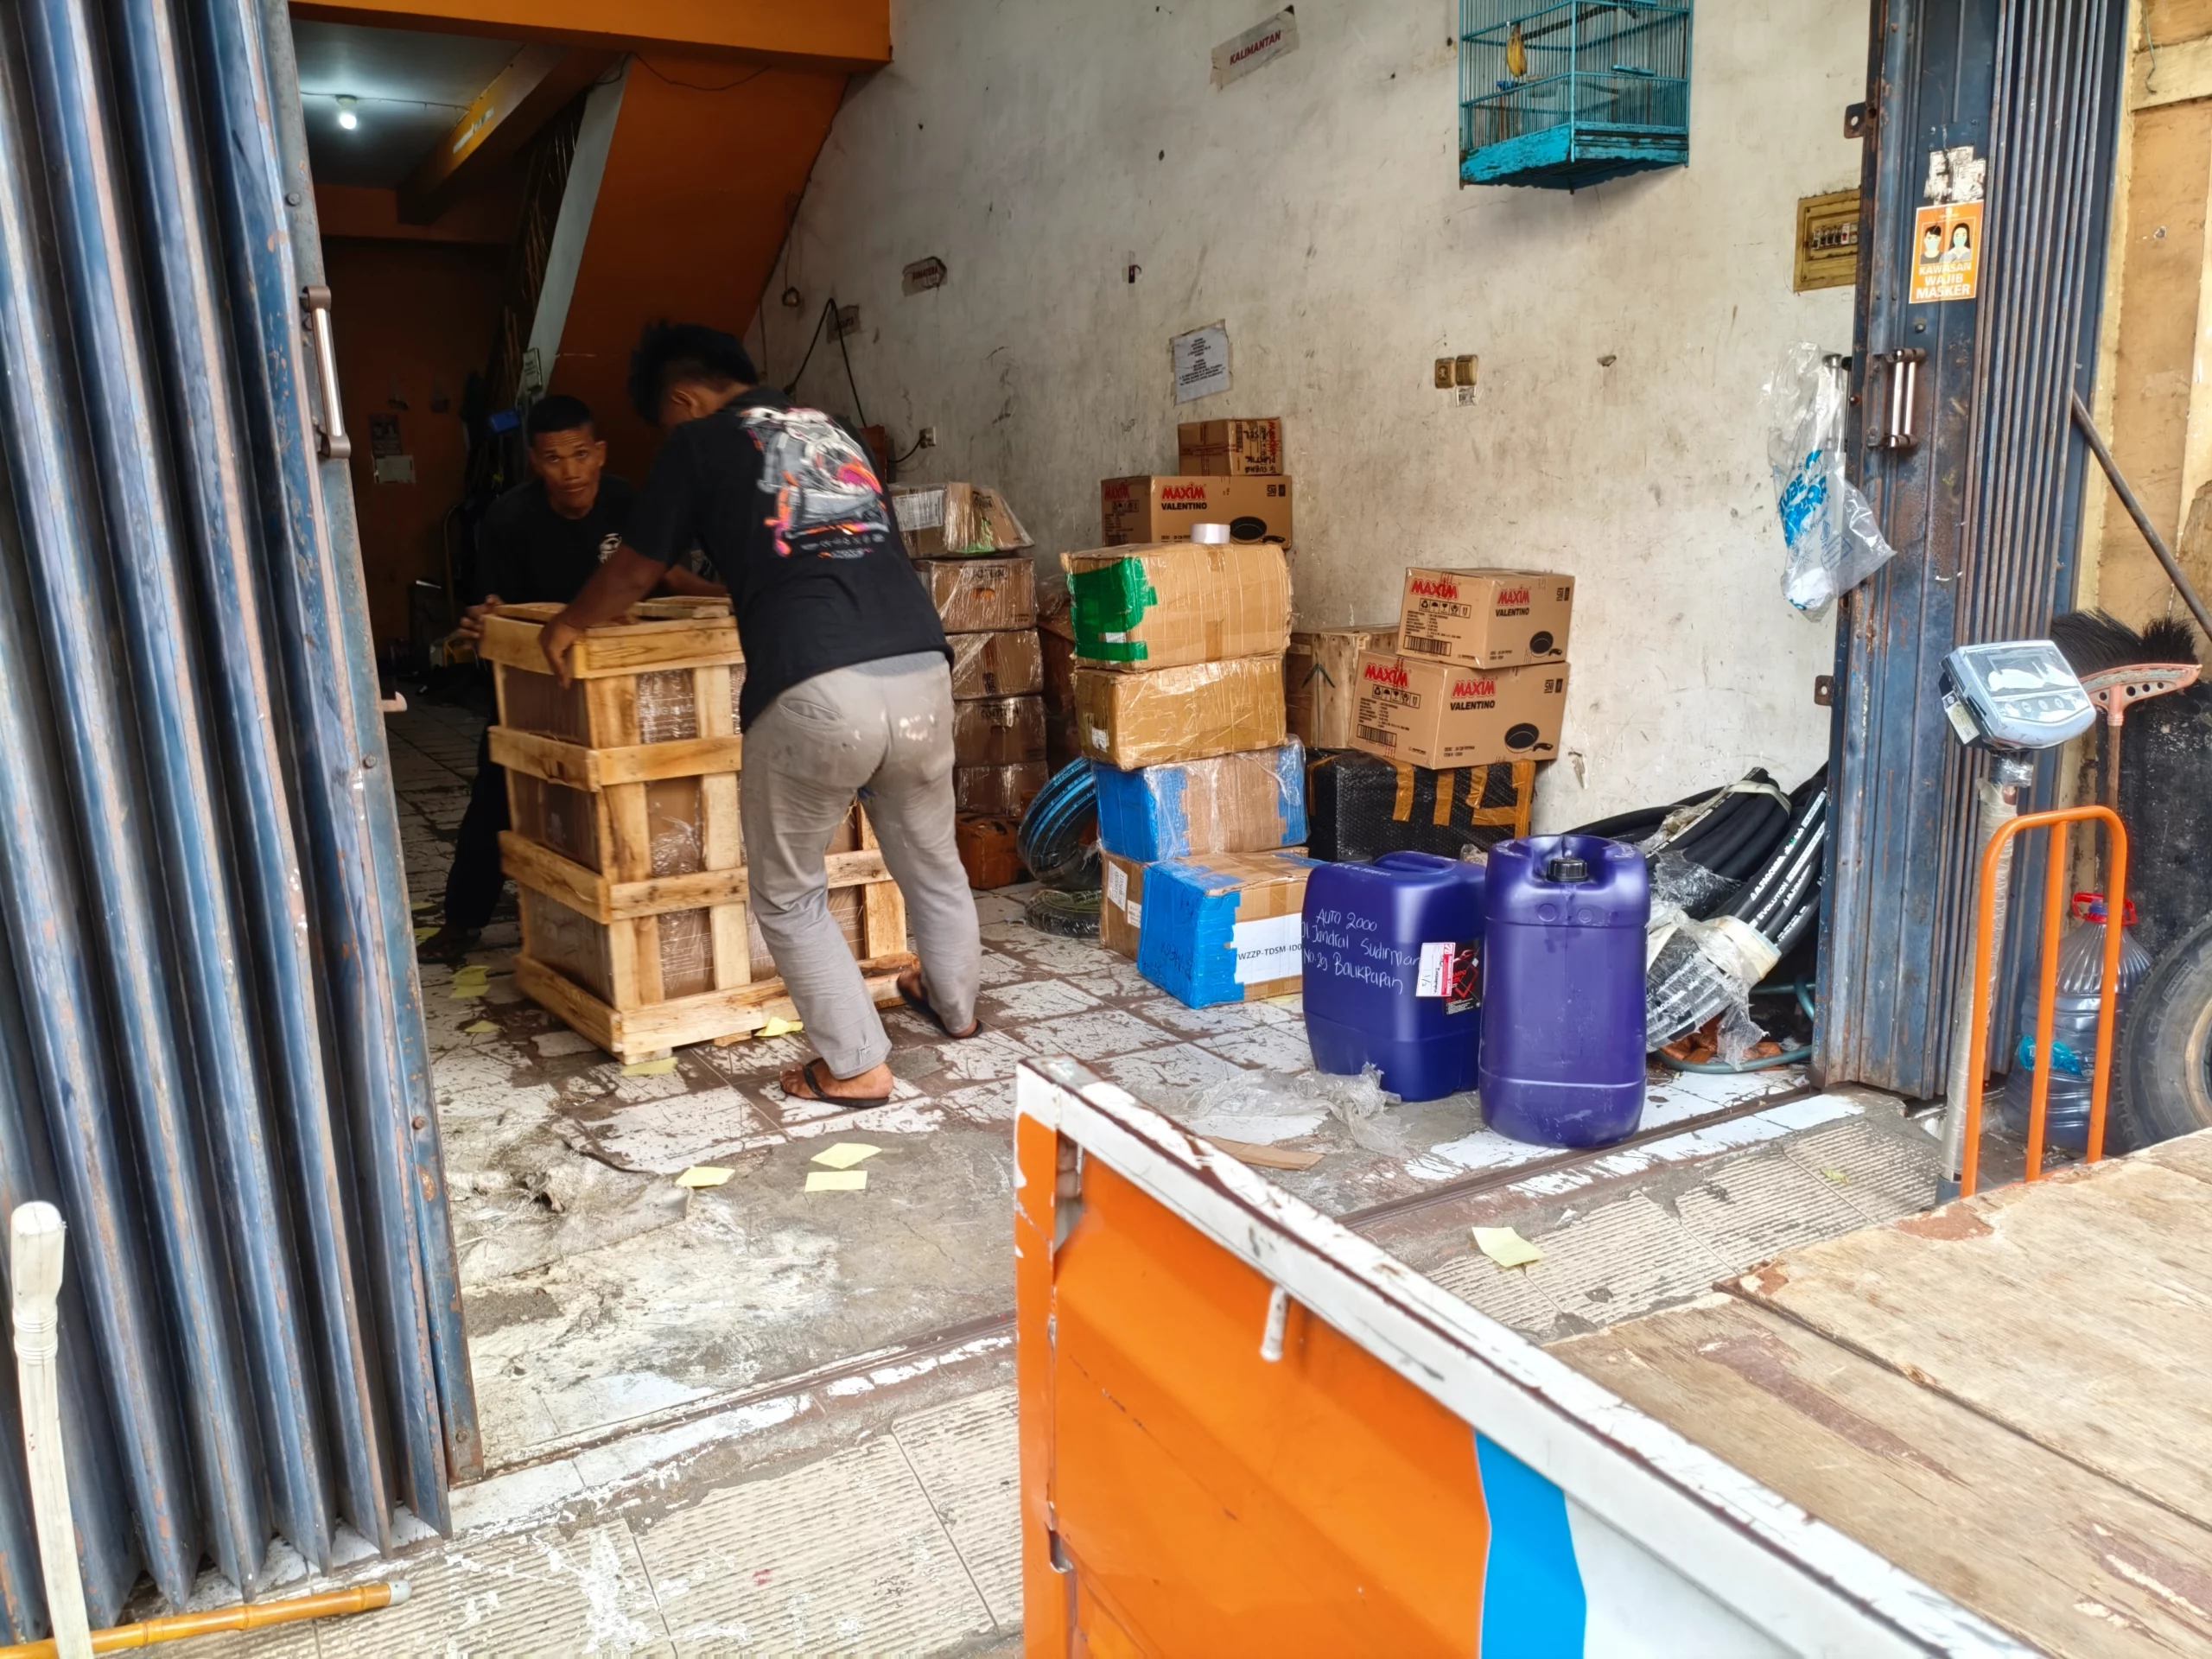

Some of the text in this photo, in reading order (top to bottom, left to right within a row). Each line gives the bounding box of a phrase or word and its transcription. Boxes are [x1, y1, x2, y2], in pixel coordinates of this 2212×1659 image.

[1230, 30, 1281, 66] KALIMANTAN
[1918, 262, 1973, 276] KAWASAN
[1924, 273, 1963, 286] WAJIB
[1915, 283, 1971, 300] MASKER
[1161, 482, 1206, 500] MAXIM
[1160, 502, 1208, 511] VALENTINO
[1410, 578, 1459, 601] MAXIM
[1497, 586, 1530, 606] MAXIM
[1496, 607, 1529, 617] VALENTINO
[1363, 663, 1409, 689] MAXIM
[1452, 676, 1496, 698] MAXIM
[1450, 700, 1496, 711] VALENTINO
[1757, 881, 1789, 921] EVOLUTION
[1316, 908, 1377, 931] AUTO 2000
